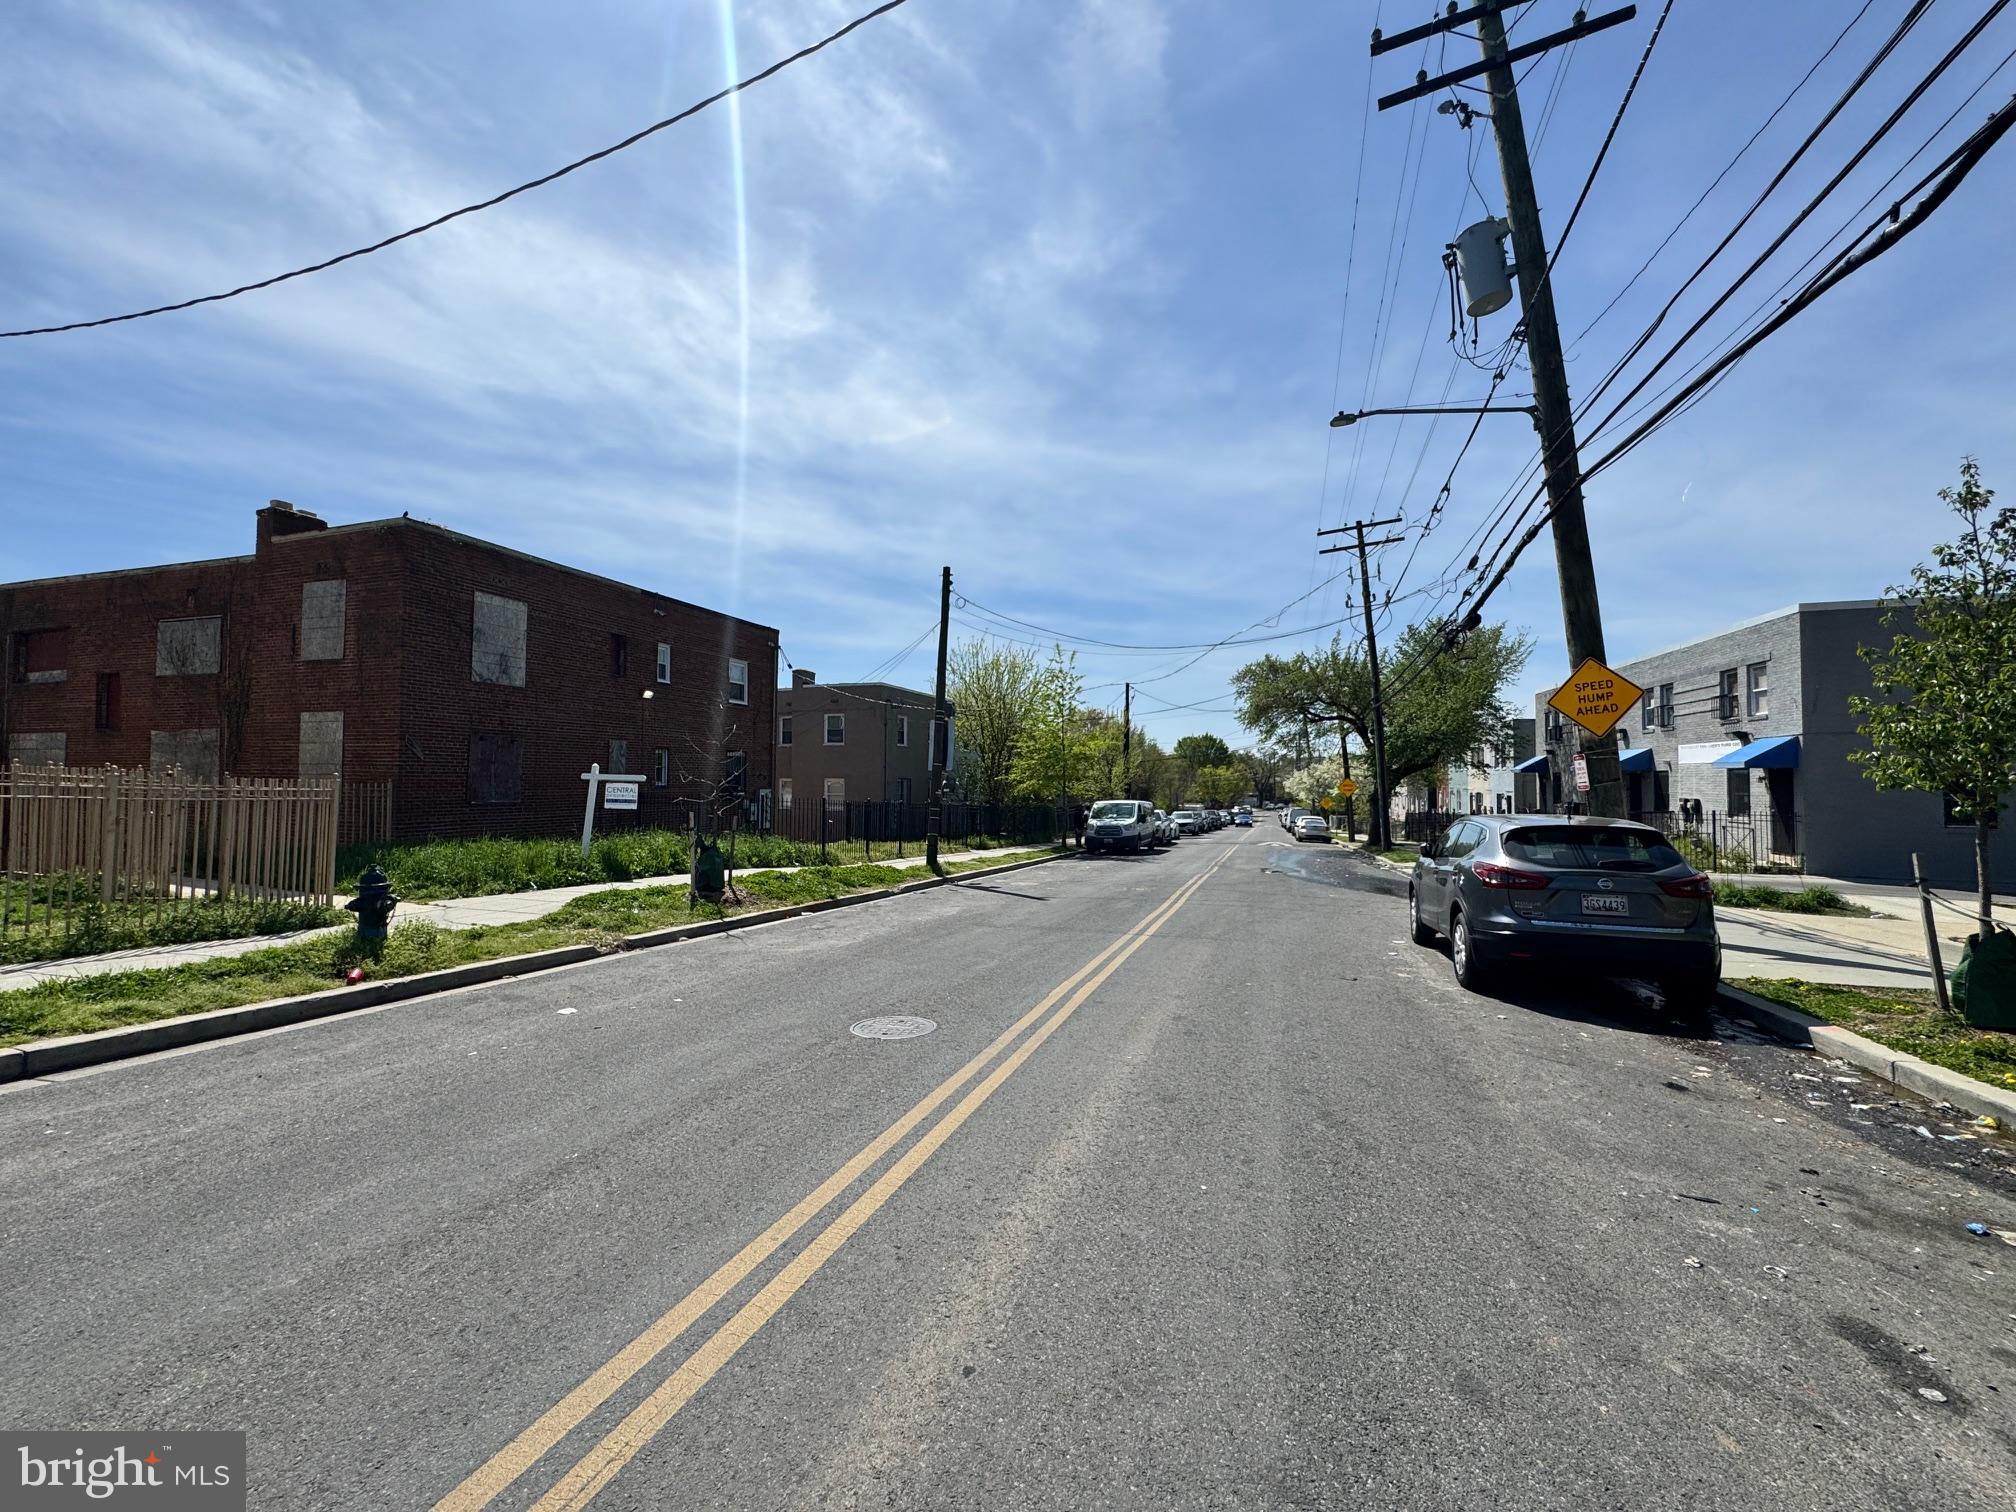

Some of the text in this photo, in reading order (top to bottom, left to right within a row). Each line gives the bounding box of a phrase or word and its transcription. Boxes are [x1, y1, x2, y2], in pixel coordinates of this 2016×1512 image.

[1574, 679, 1614, 693] SPEED
[1578, 692, 1614, 704] HUMP
[1576, 703, 1619, 717] AHEAD
[607, 786, 636, 794] CENTRAL
